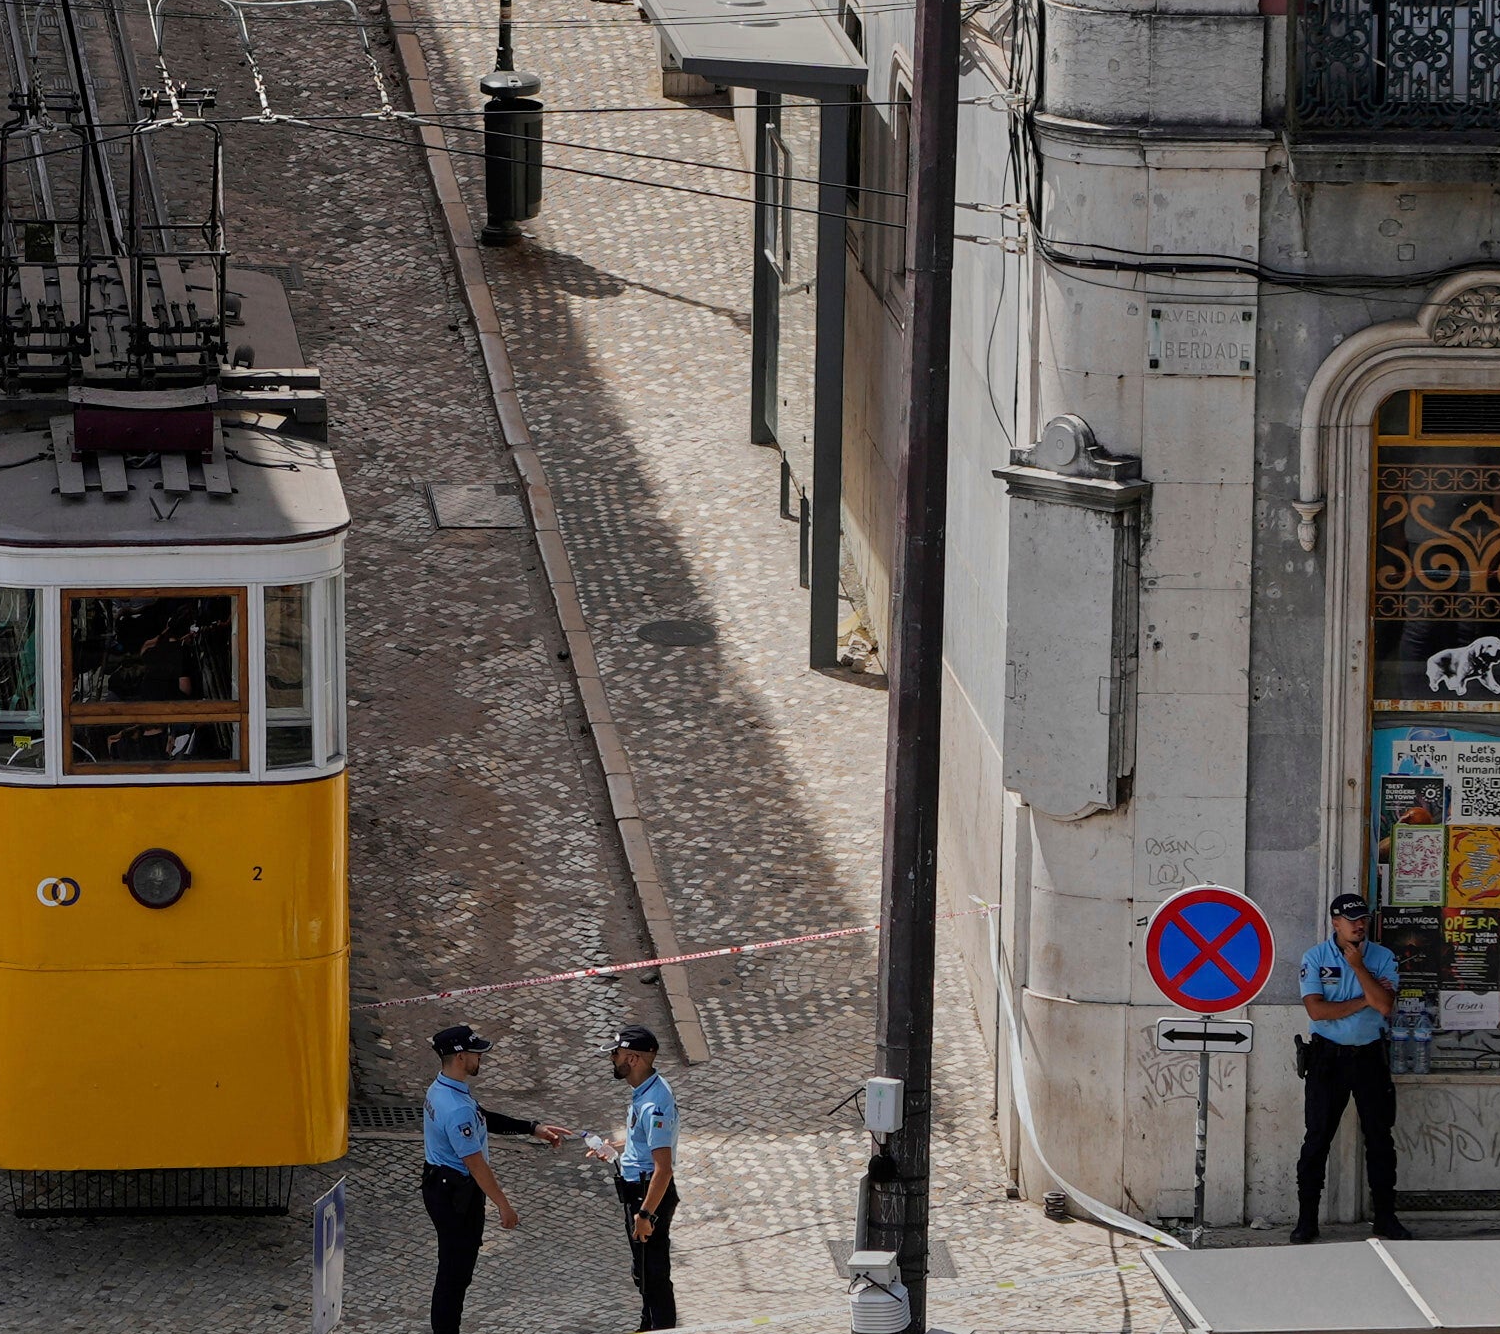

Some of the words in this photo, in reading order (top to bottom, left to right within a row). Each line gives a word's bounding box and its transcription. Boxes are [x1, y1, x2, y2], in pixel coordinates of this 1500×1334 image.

[1162, 308, 1240, 324] AVENIDA
[1191, 328, 1208, 338] DA
[1147, 340, 1250, 359] LIBERDADE
[1410, 744, 1435, 753] Let's
[1470, 745, 1496, 754] Let's
[252, 866, 263, 881] 2
[1445, 917, 1499, 930] OPERA
[1444, 931, 1474, 943] FEST
